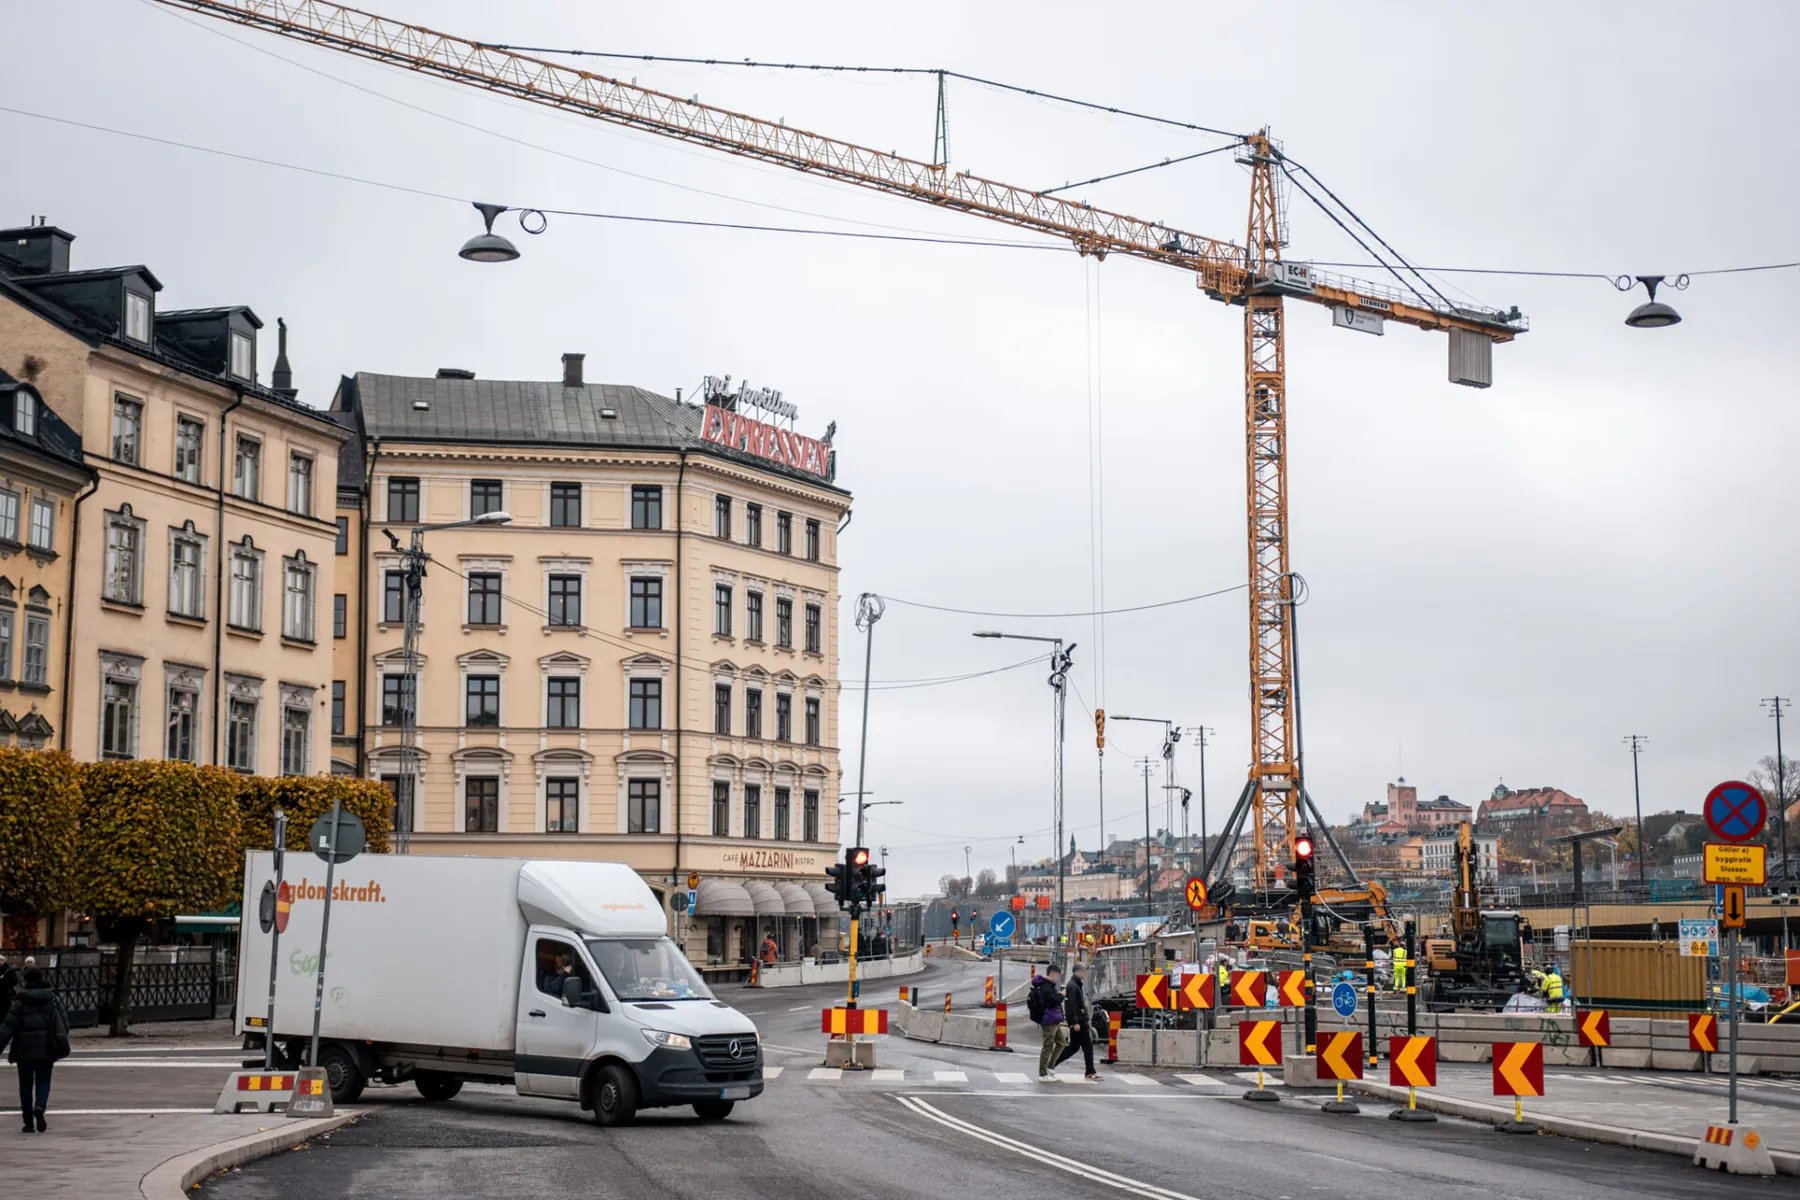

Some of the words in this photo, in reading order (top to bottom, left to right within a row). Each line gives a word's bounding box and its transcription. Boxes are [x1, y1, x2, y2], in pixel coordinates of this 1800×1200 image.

[700, 403, 831, 477] EXPRESSEN
[740, 851, 794, 869] MAZZARINI
[1715, 856, 1752, 864] byggtrafik
[1720, 865, 1748, 873] Slussen
